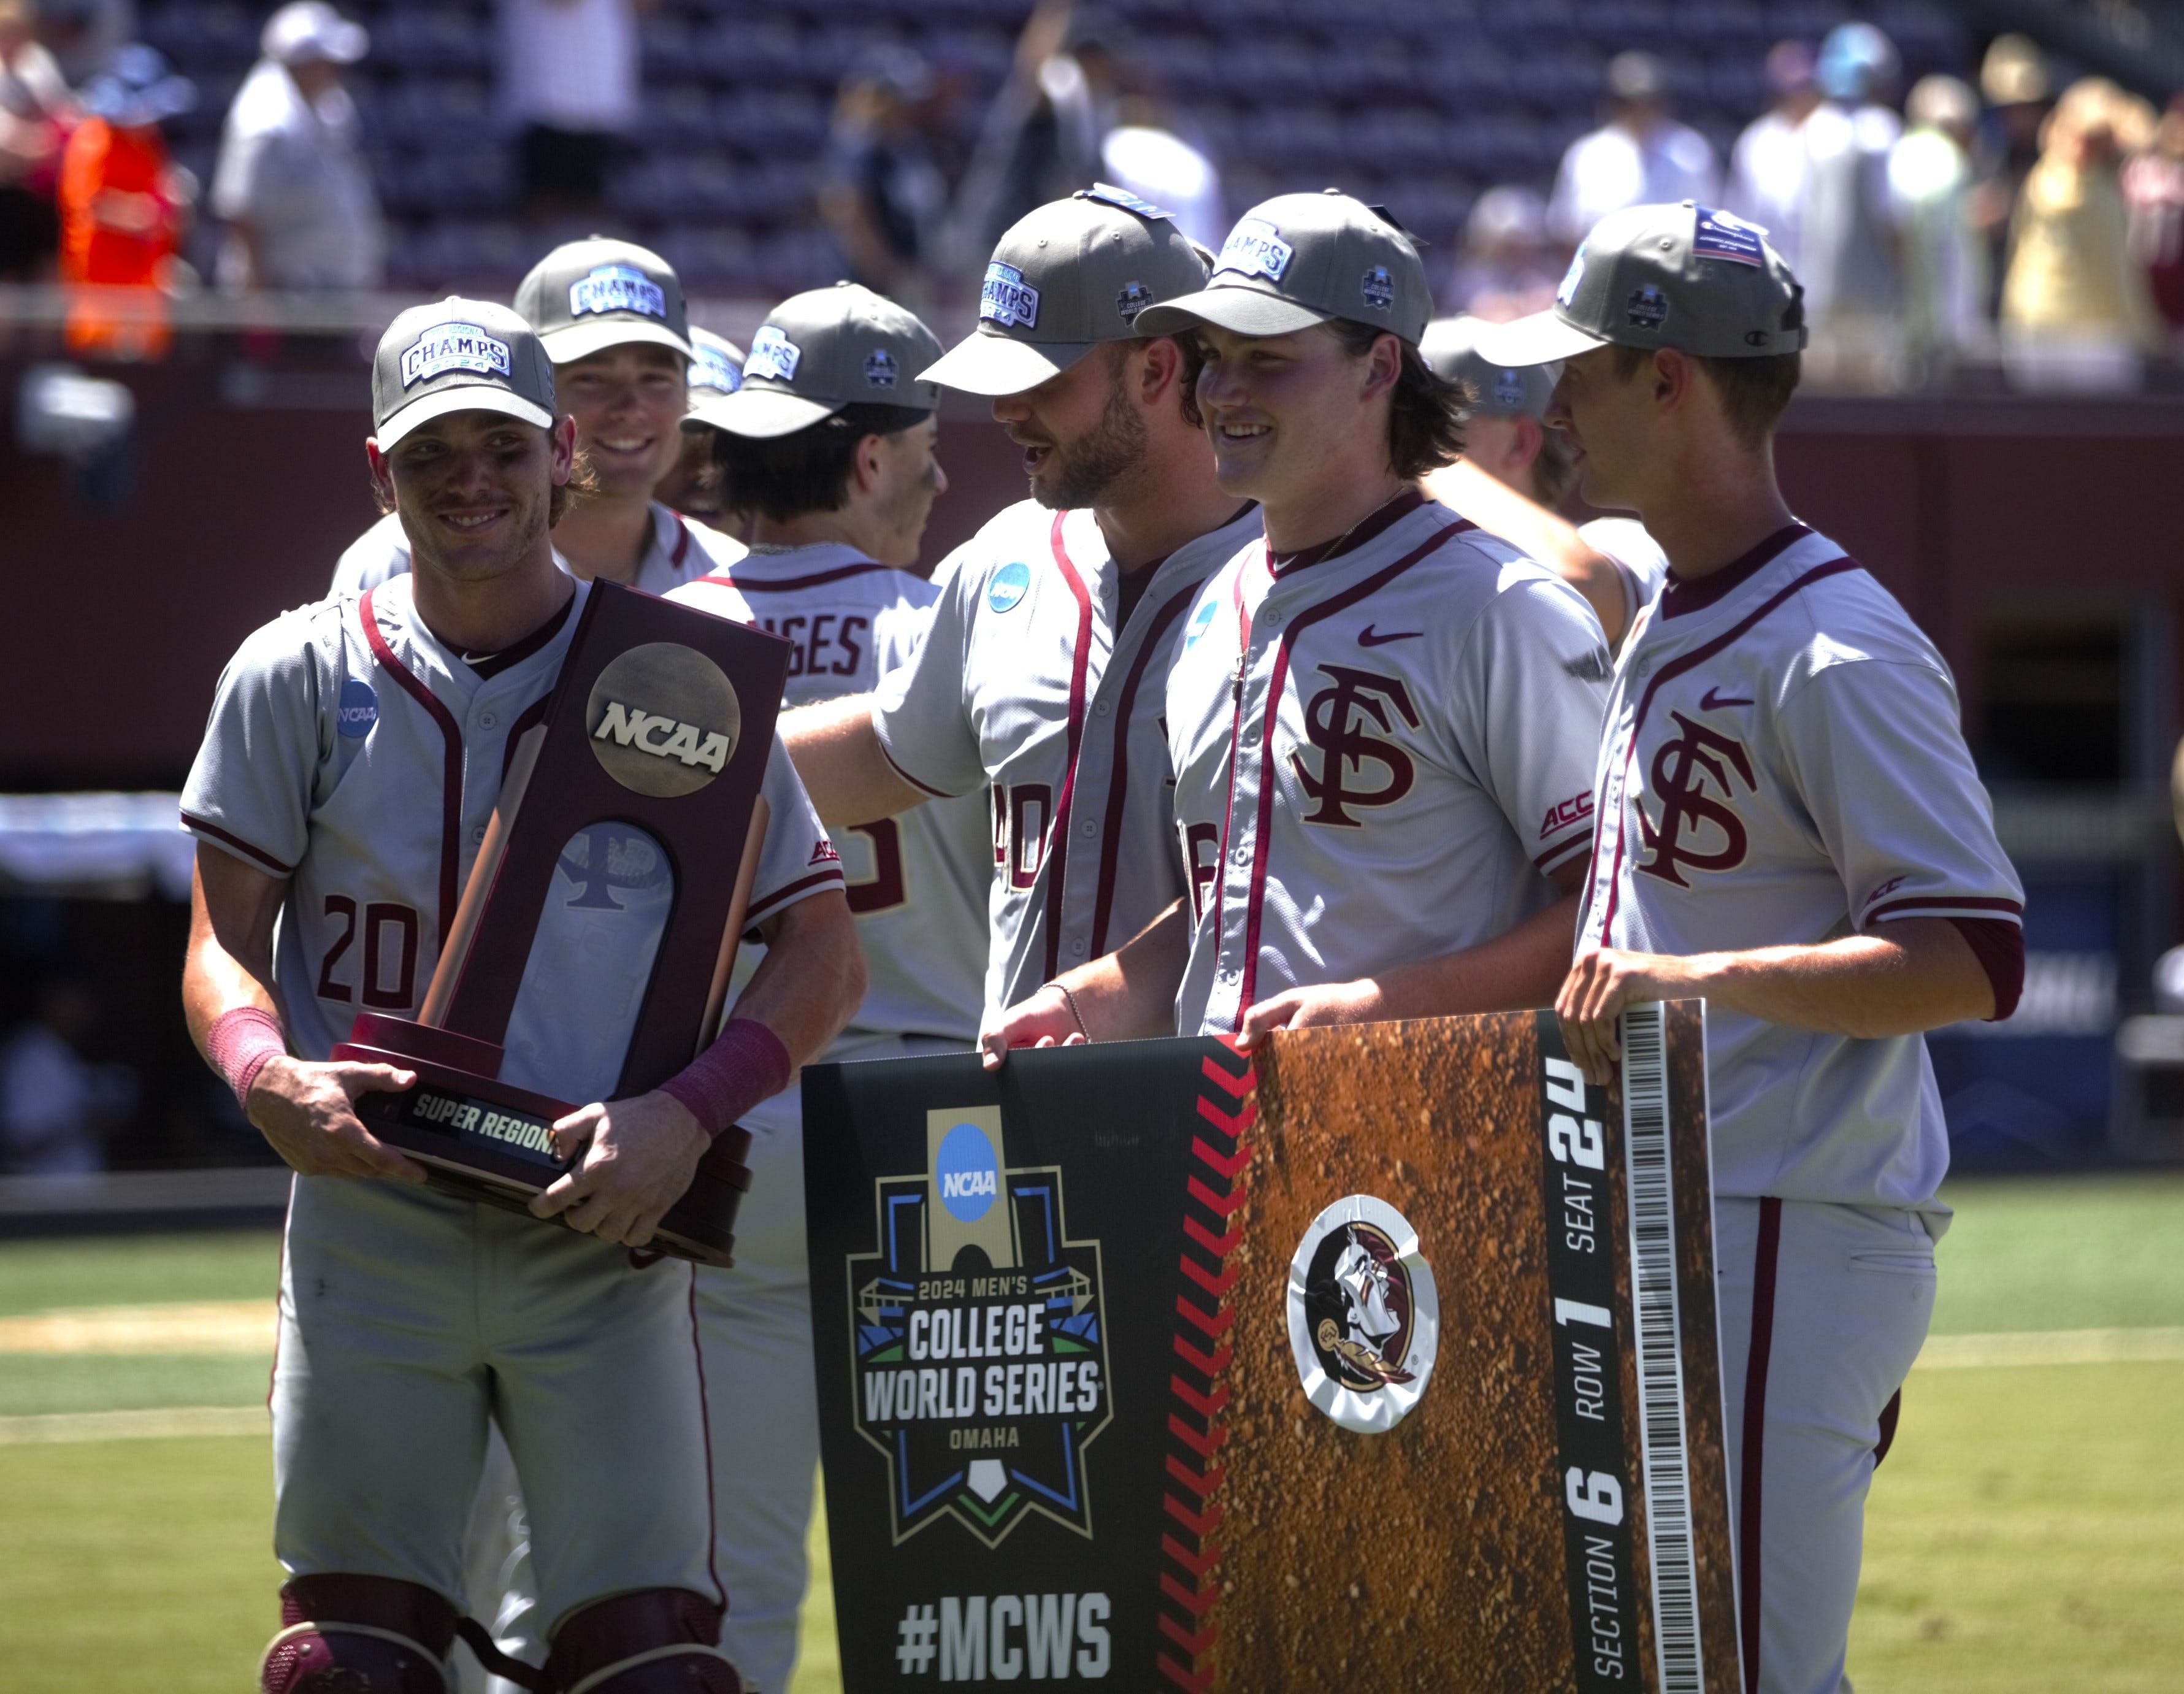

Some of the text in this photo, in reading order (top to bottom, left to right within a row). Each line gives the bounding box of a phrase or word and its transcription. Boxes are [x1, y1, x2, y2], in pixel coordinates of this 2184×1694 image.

[1225, 236, 1284, 270] AMPS
[409, 338, 505, 375] CHAMPS
[338, 707, 375, 722] NCAA
[594, 701, 730, 773] NCAA
[1541, 790, 1594, 834] ACC
[317, 895, 419, 1010] 20
[413, 1094, 554, 1154] SUPER REGION
[943, 1170, 997, 1198] NCAA
[919, 1275, 1027, 1300] 2024 MEN'S
[909, 1303, 1045, 1361] COLLEGE
[865, 1360, 1098, 1422] WORLD SERIES
[1545, 1056, 1624, 1679] SECTION 6 ROW 1 SEAT 24
[949, 1427, 1020, 1450] OMAHA
[895, 1592, 1111, 1682] #MCWS
